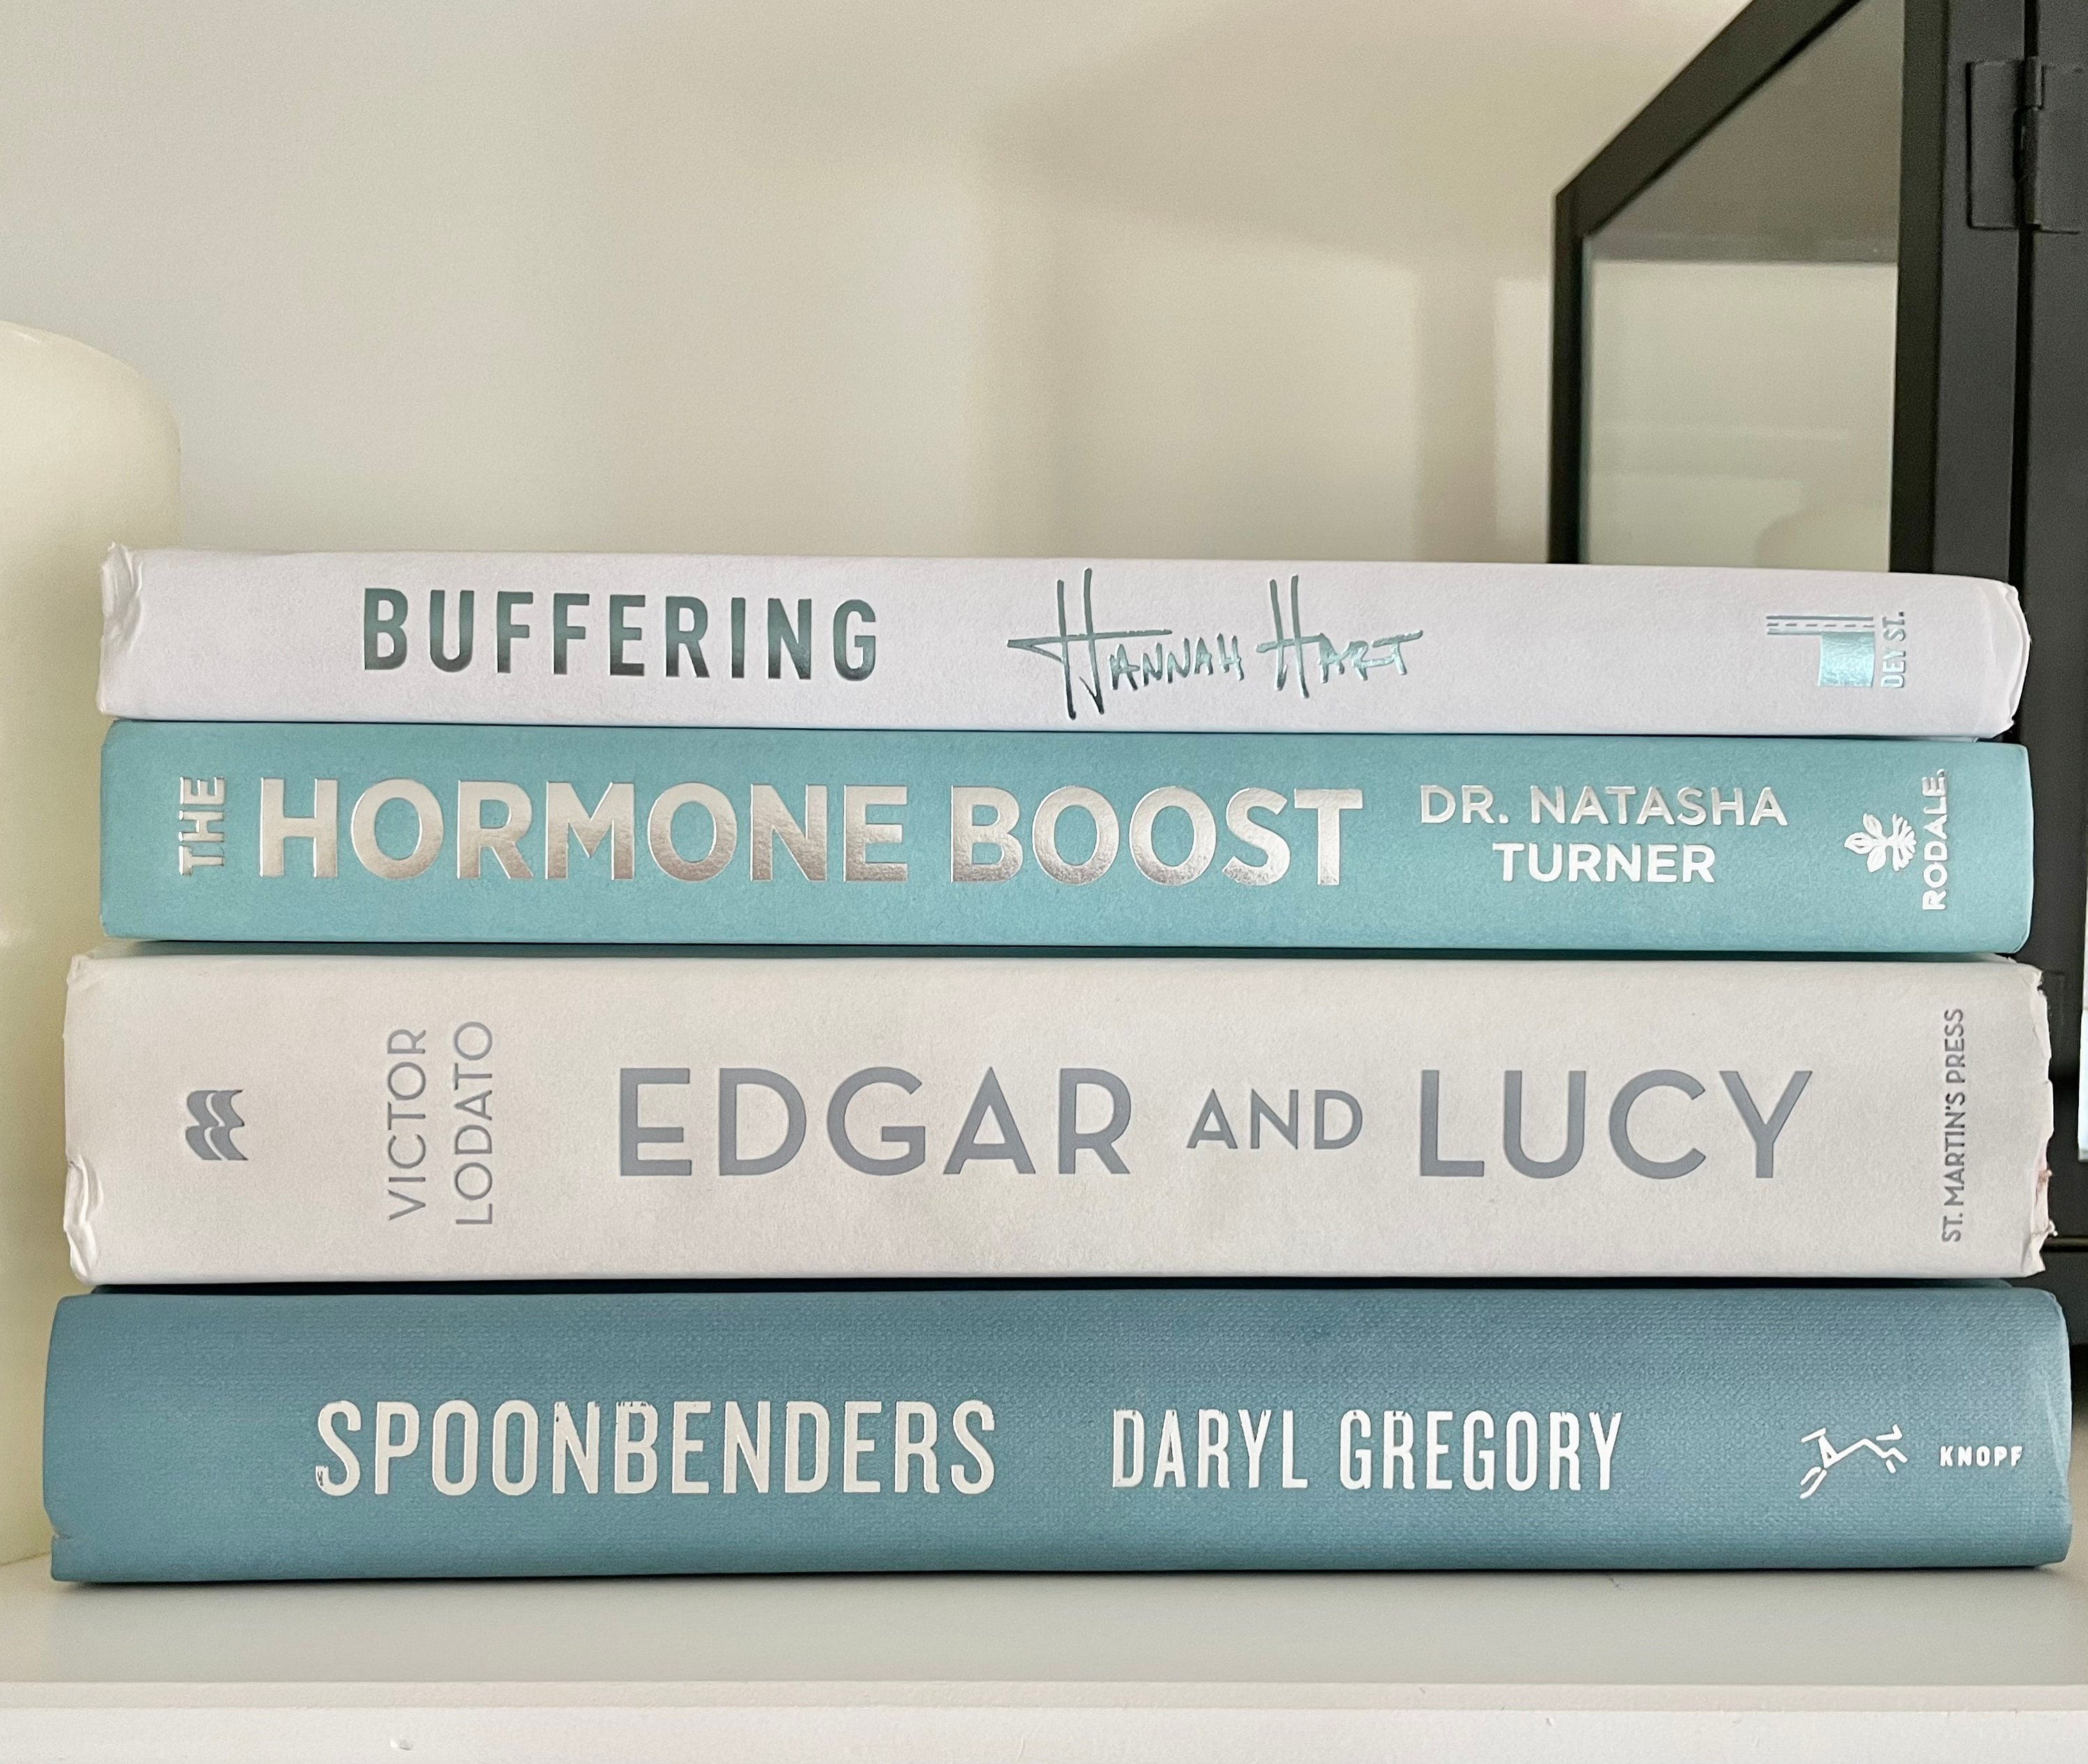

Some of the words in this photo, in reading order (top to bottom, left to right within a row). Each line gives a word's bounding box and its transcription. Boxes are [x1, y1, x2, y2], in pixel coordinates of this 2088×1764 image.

[364, 588, 877, 682] BUFFERING
[1881, 649, 1906, 688] DEY
[1882, 611, 1906, 641] ST.
[178, 776, 226, 875] THE
[260, 778, 909, 882] HORMONE
[951, 787, 1363, 886] BOOST
[1421, 785, 1509, 824] DR.
[1531, 786, 1787, 826] NATASHA
[1494, 844, 1715, 883] TURNER
[1944, 1007, 1966, 1084] PRESS
[387, 1028, 427, 1220] VICTOR
[454, 1021, 493, 1225] LODATO
[620, 1066, 1132, 1176] EDGAR
[1187, 1088, 1363, 1149] AND
[1420, 1069, 1812, 1179] LUCY
[1944, 1092, 1966, 1205] MARTIN'S
[1942, 1211, 1963, 1242] ST.
[315, 1399, 996, 1496] SPOONBENDERS
[1112, 1410, 1309, 1489] DARYL
[1339, 1410, 1623, 1490] GREGORY
[1939, 1446, 2023, 1467] KNOPF
